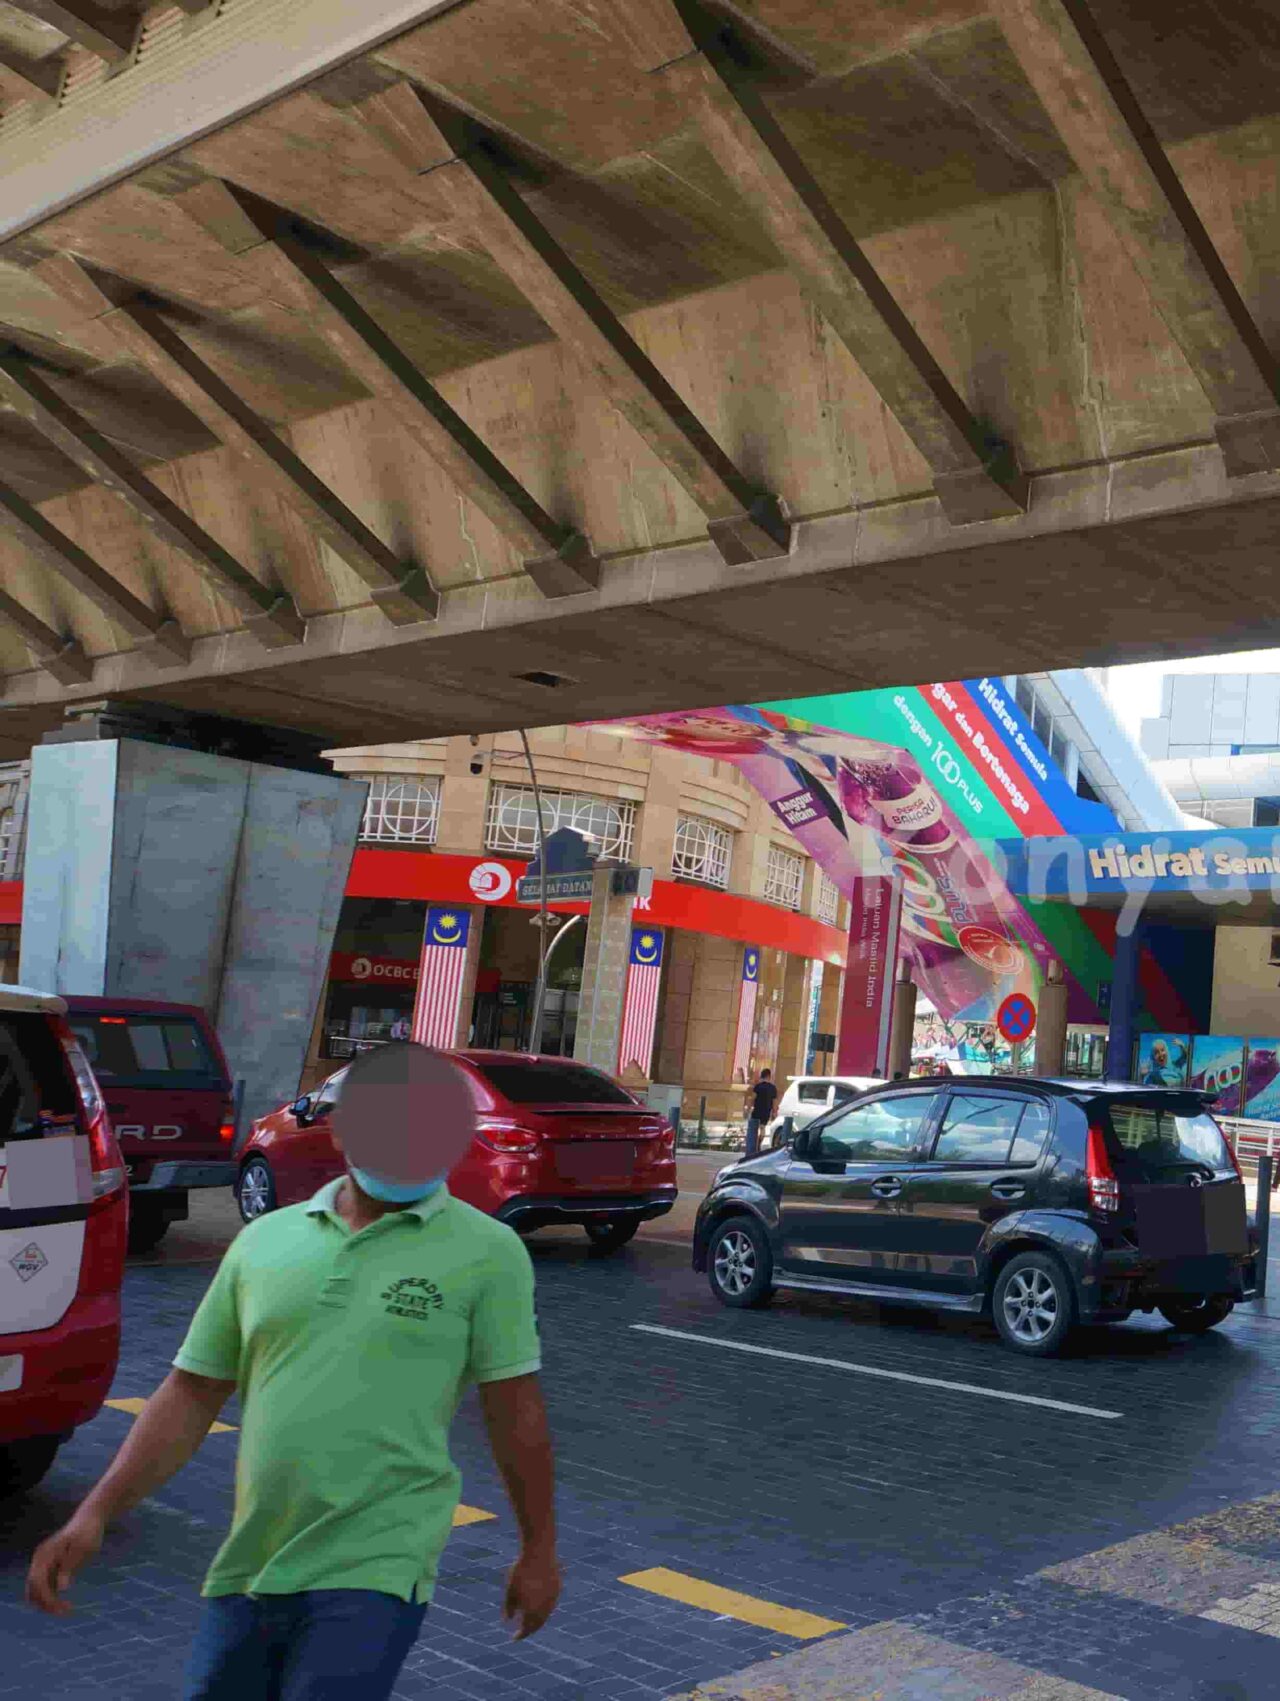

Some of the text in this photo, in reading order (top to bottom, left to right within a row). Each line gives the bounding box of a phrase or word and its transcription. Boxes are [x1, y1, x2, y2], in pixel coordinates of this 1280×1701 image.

[894, 695, 932, 747] dengan
[978, 678, 1048, 781] Hidrat Semula
[931, 682, 1030, 815] gar dan Bertenaga
[1088, 843, 1208, 879] Hidrat
[562, 881, 592, 893] DATAN
[868, 931, 881, 972] Masjid
[373, 964, 411, 978] OCBC
[866, 976, 877, 1008] India
[115, 1125, 182, 1140] RD
